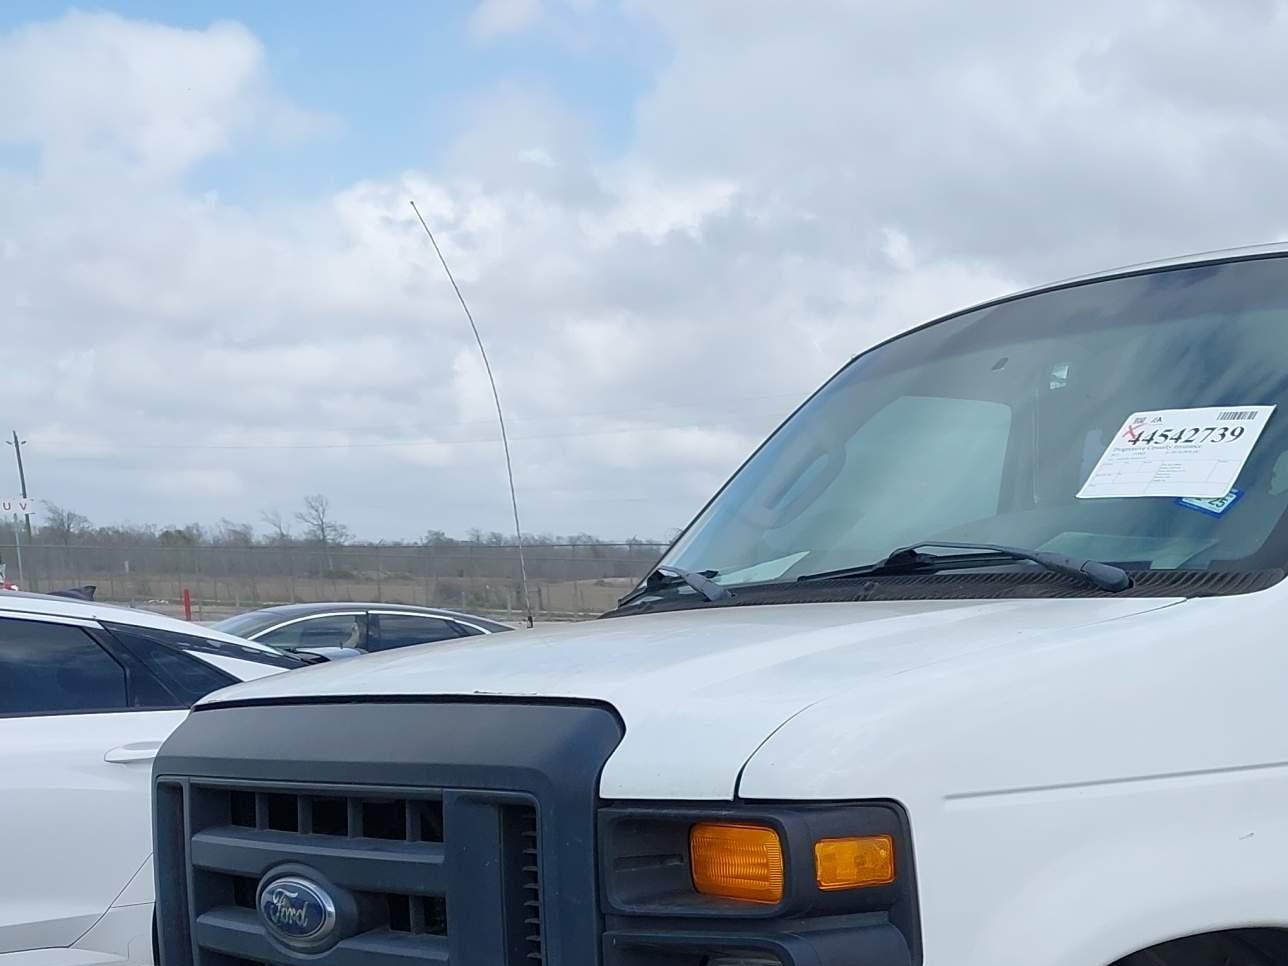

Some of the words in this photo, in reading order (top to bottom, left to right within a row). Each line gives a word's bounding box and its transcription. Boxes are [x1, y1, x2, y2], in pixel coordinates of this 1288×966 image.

[1128, 426, 1245, 446] 44542739
[3, 502, 11, 511] U
[19, 503, 27, 511] V
[271, 888, 309, 927] Ford
